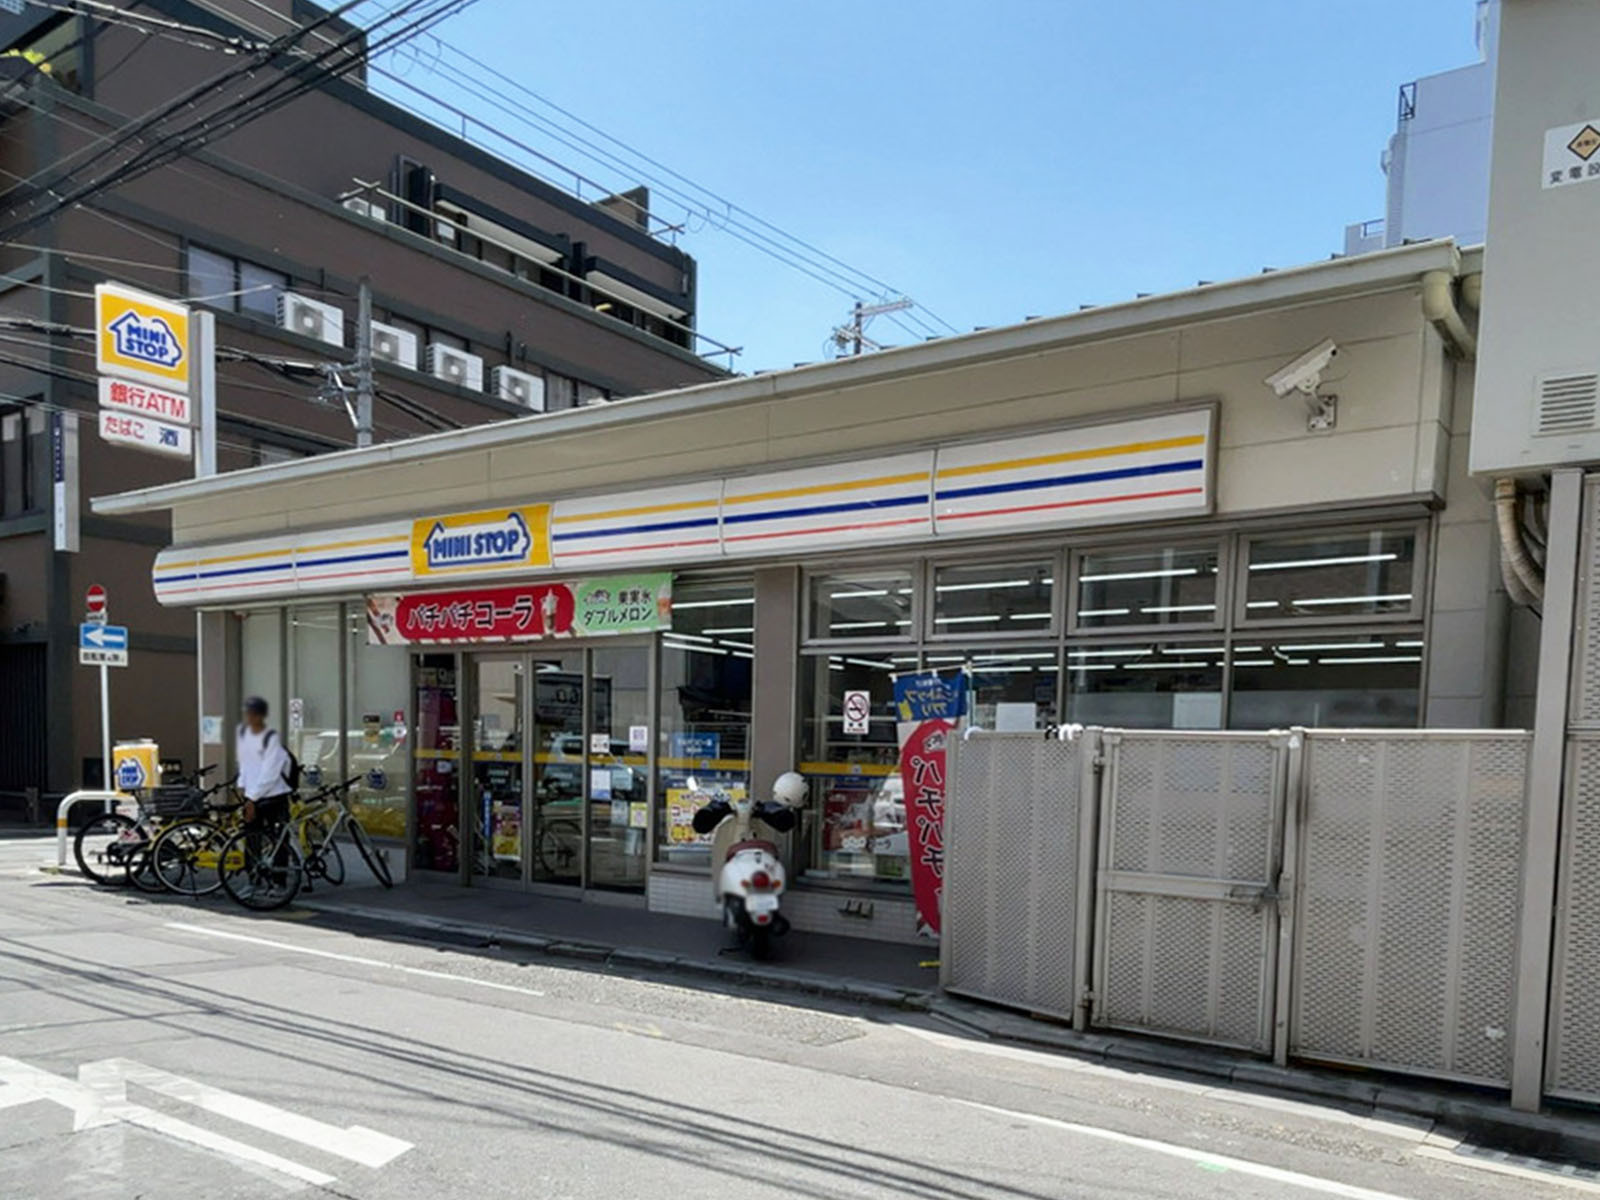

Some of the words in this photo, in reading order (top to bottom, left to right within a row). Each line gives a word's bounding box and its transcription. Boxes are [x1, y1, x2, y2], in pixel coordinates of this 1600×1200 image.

[126, 322, 167, 343] MINI
[125, 338, 169, 359] STOP
[109, 381, 185, 419] 銀行ATM
[105, 415, 145, 439] たばこ
[159, 426, 179, 447] 酒
[432, 534, 471, 559] MINI
[473, 529, 520, 555] STOP
[407, 595, 534, 632] パチパチコーラ
[583, 605, 653, 627] ダブルメロン
